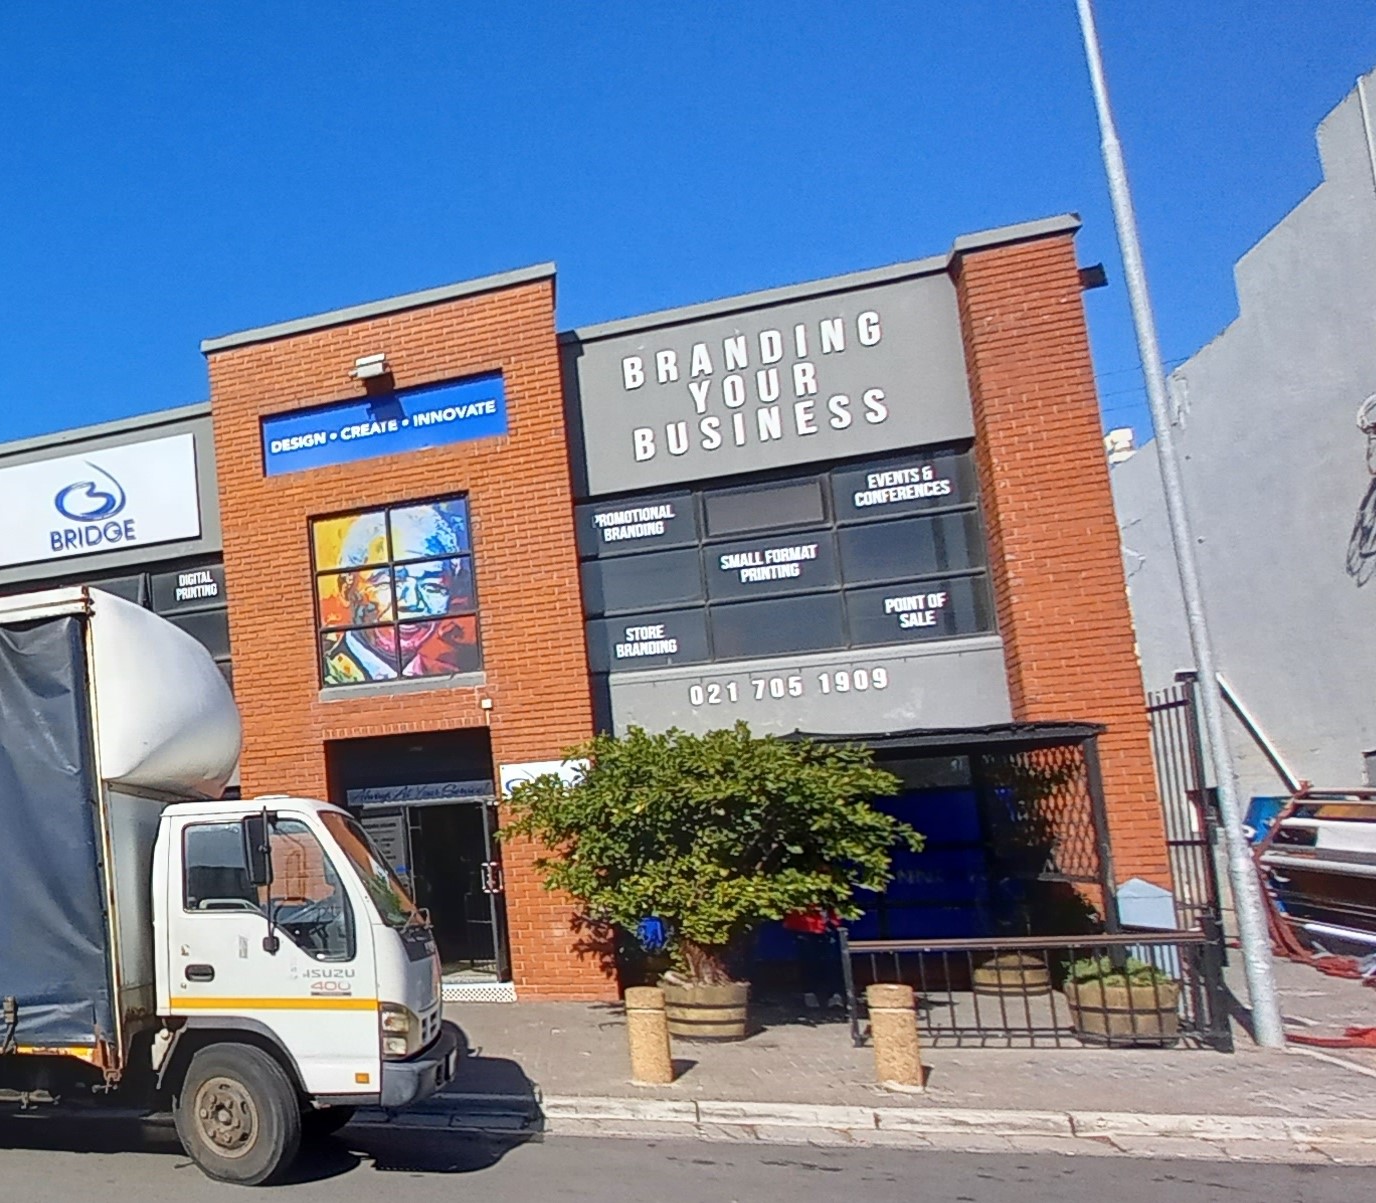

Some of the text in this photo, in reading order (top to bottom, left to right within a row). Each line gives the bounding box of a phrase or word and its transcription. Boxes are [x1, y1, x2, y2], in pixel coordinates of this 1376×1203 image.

[622, 311, 882, 390] BRANDING
[688, 362, 818, 414] YOUR
[271, 400, 496, 454] DESIGN CREATE INNOVATE
[633, 388, 888, 462] BUSINESS
[867, 465, 934, 489] EVENTS &
[854, 480, 951, 507] CONFERENCES
[592, 504, 675, 529] PROMOTIONAL
[50, 518, 137, 552] BRIDGE
[603, 521, 665, 542] BRANDING
[720, 544, 818, 570] SMALL FORMAT
[178, 570, 213, 587] DIGITAL
[739, 563, 801, 583] PRINTING
[175, 583, 218, 601] PRINTING
[884, 592, 947, 614] POINT OF
[899, 611, 936, 629] SALE
[625, 624, 666, 642] STORE
[615, 639, 678, 658] BRANDING
[689, 667, 888, 706] 021 705 1909
[306, 969, 355, 978] ISUZU
